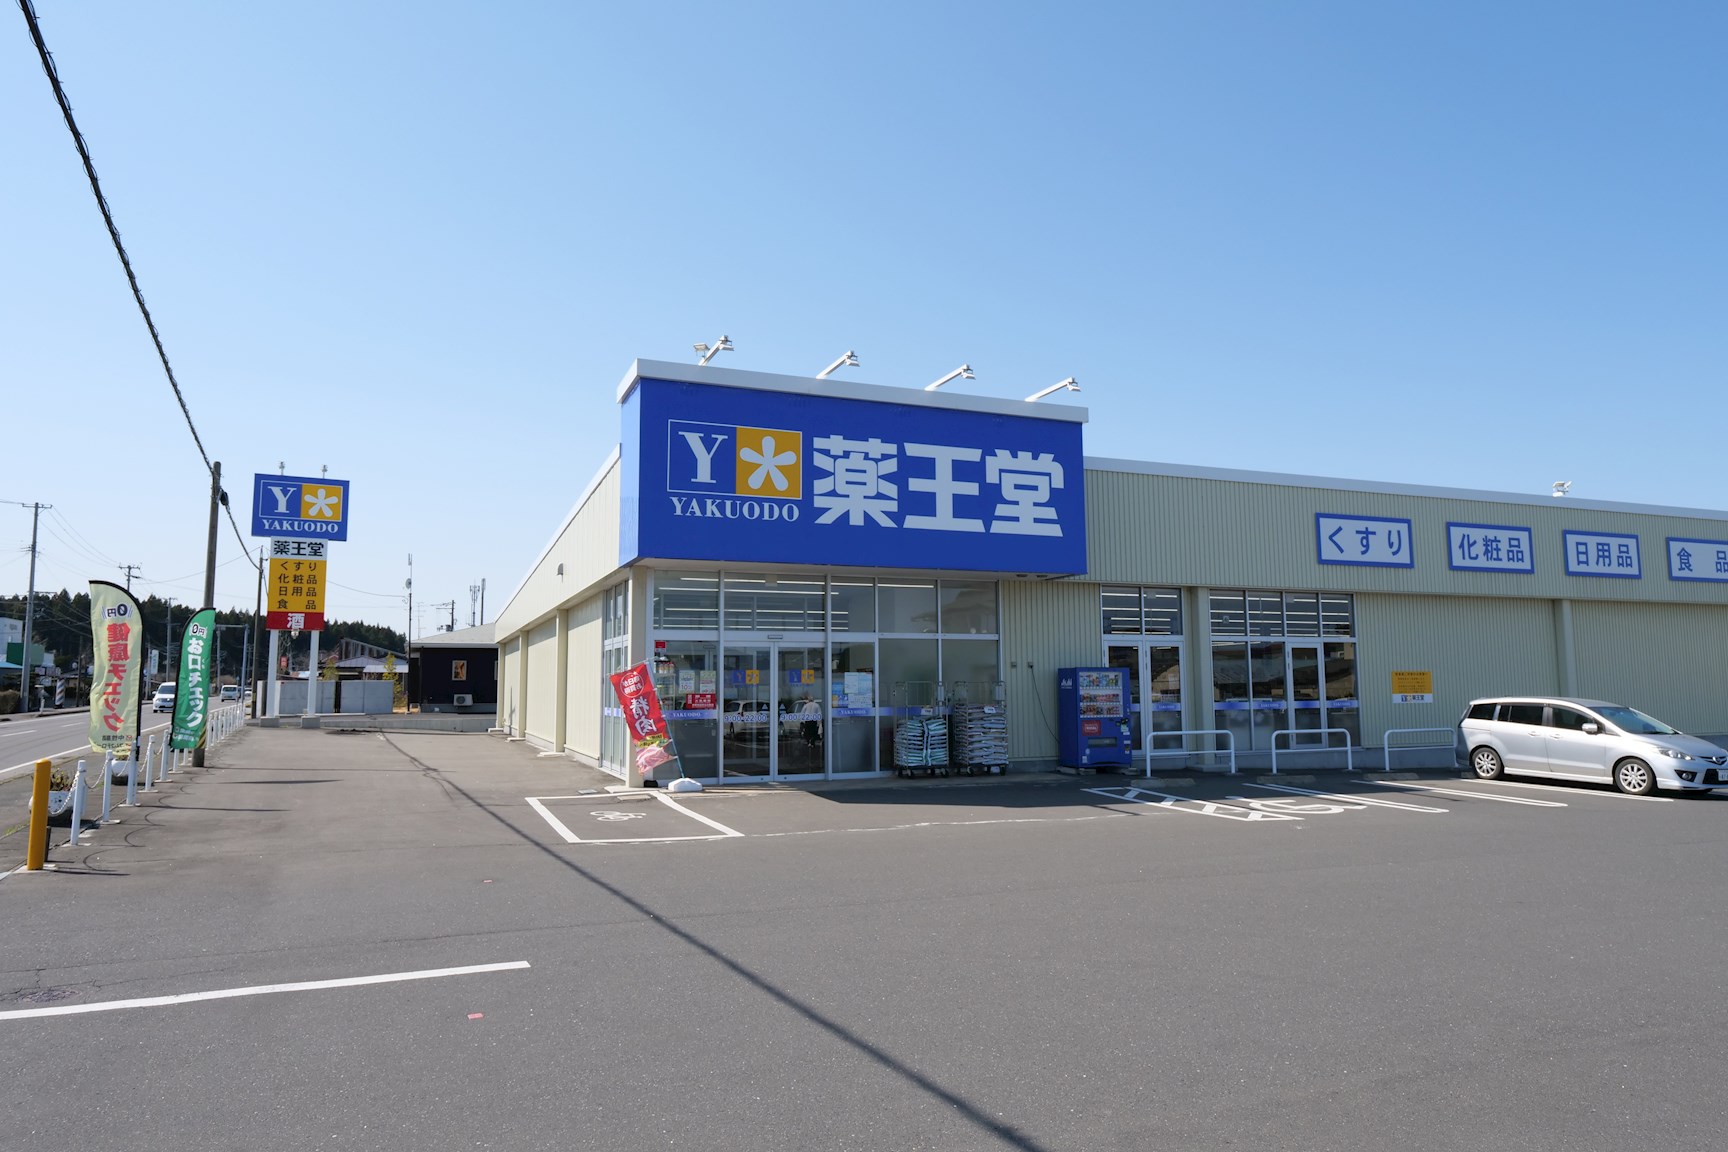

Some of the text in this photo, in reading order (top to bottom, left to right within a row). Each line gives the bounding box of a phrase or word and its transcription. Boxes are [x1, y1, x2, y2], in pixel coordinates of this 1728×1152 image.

[679, 431, 728, 483] Y
[813, 435, 1064, 537] 薬王堂
[267, 486, 297, 513] Y
[670, 497, 799, 522] YAKUODO
[262, 519, 338, 533] YAKUODO
[273, 540, 324, 557] 薬王堂
[1328, 526, 1402, 556] くすり
[1458, 533, 1525, 563] 化粧品
[280, 561, 317, 571] くすり
[1575, 541, 1634, 568] 日用品
[278, 573, 317, 584] 化粧品
[279, 586, 317, 597] 日用品
[287, 613, 305, 630] 酒
[187, 637, 204, 728] お口チェック
